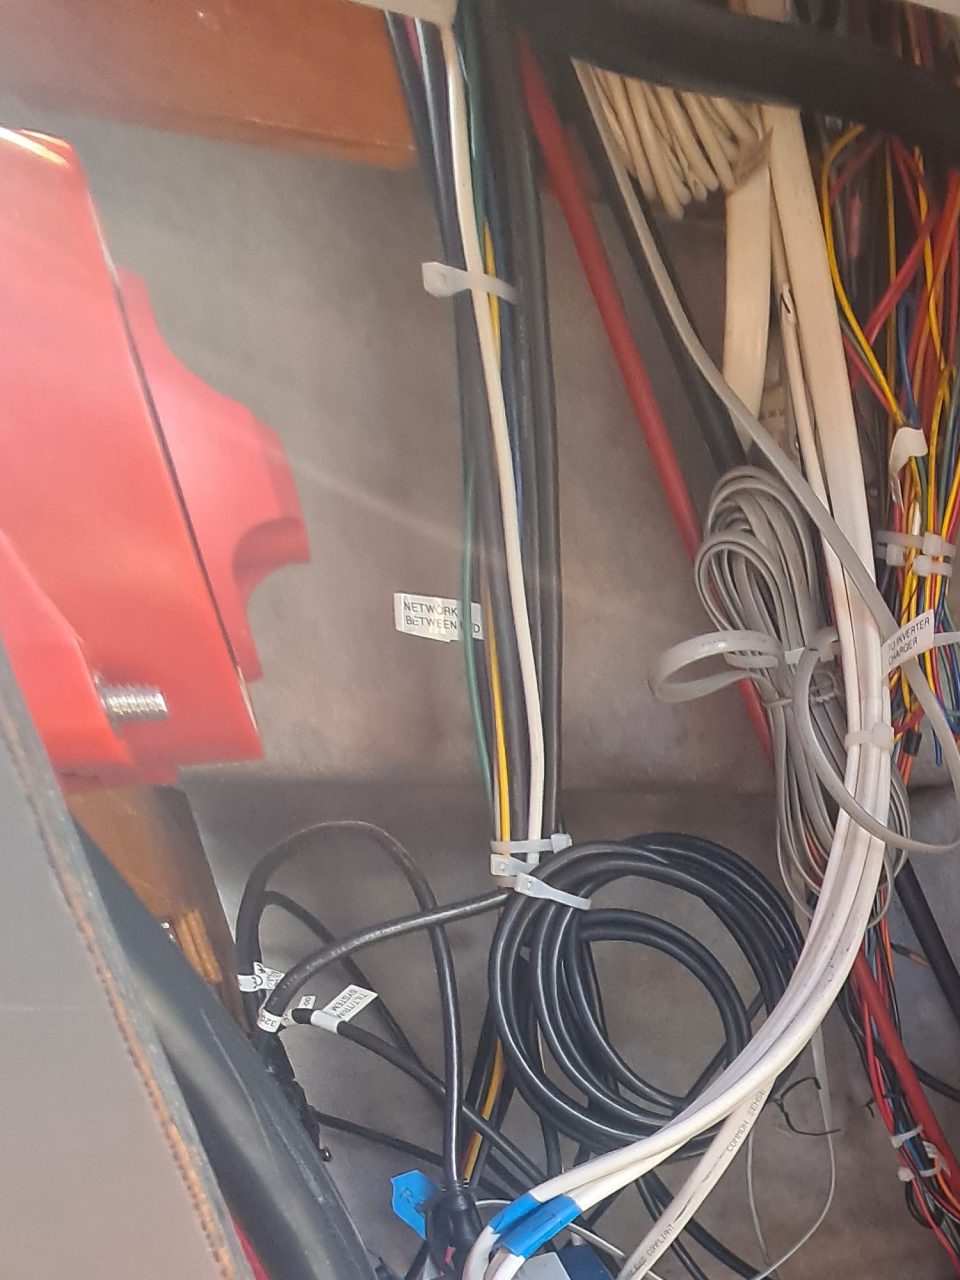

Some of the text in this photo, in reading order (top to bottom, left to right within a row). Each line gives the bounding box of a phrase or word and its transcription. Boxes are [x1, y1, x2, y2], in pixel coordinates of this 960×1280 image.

[403, 600, 458, 617] NETWORK
[405, 615, 458, 630] BETWEEN
[897, 616, 930, 644] INVERTER
